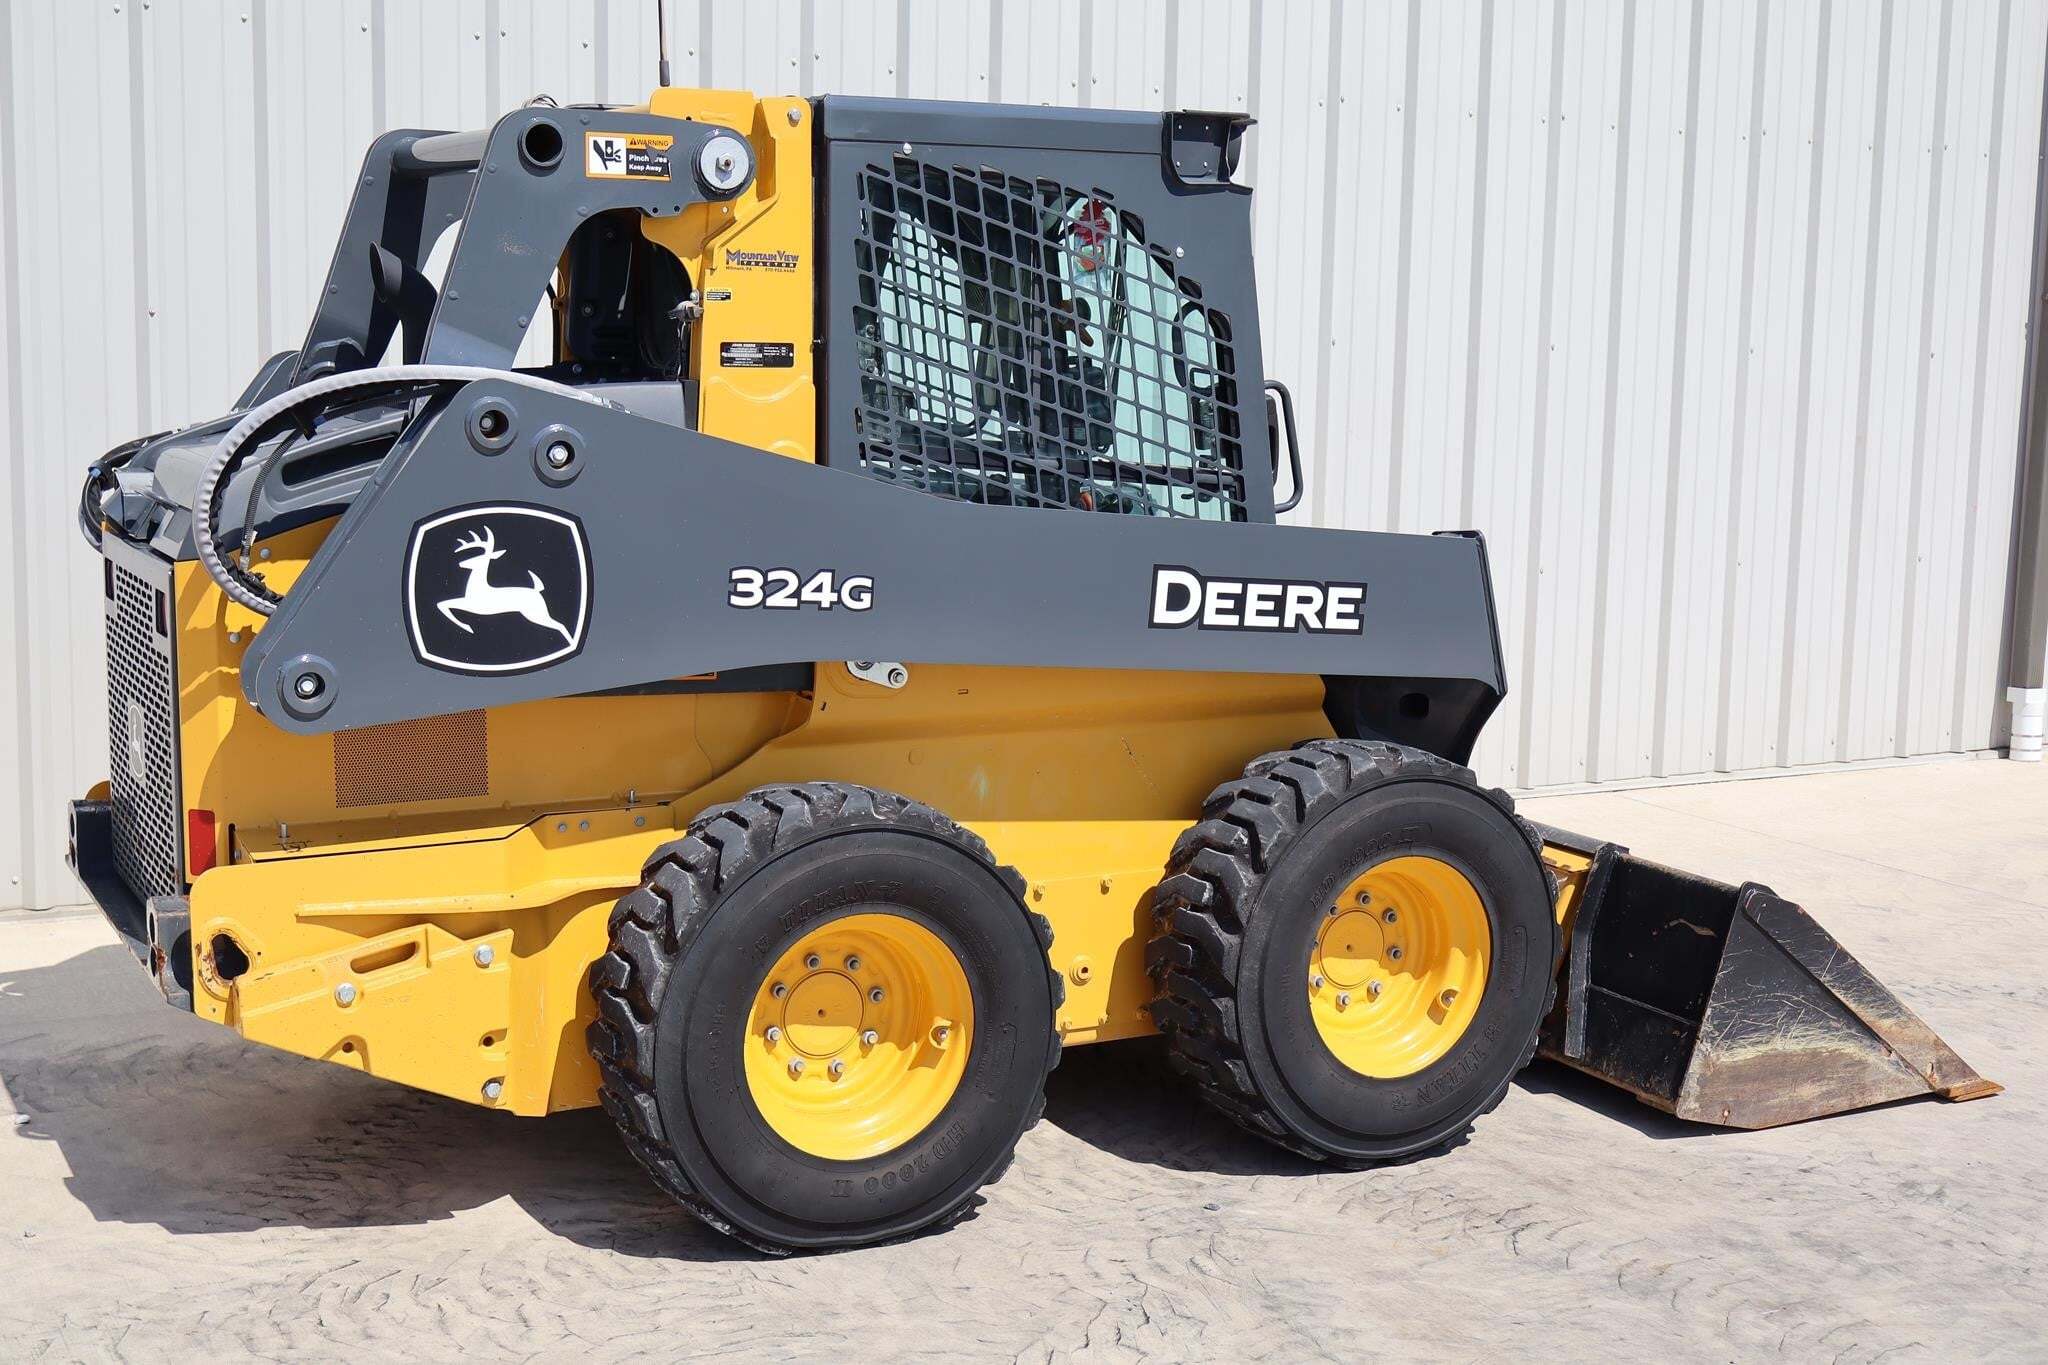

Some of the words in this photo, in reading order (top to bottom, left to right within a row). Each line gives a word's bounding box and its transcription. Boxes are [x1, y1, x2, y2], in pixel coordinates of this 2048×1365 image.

[628, 154, 650, 162] Pinch
[726, 248, 777, 265] MOUNTAIN
[777, 250, 799, 262] VIEW
[729, 567, 873, 610] 324G
[1150, 566, 1366, 633] DEERE
